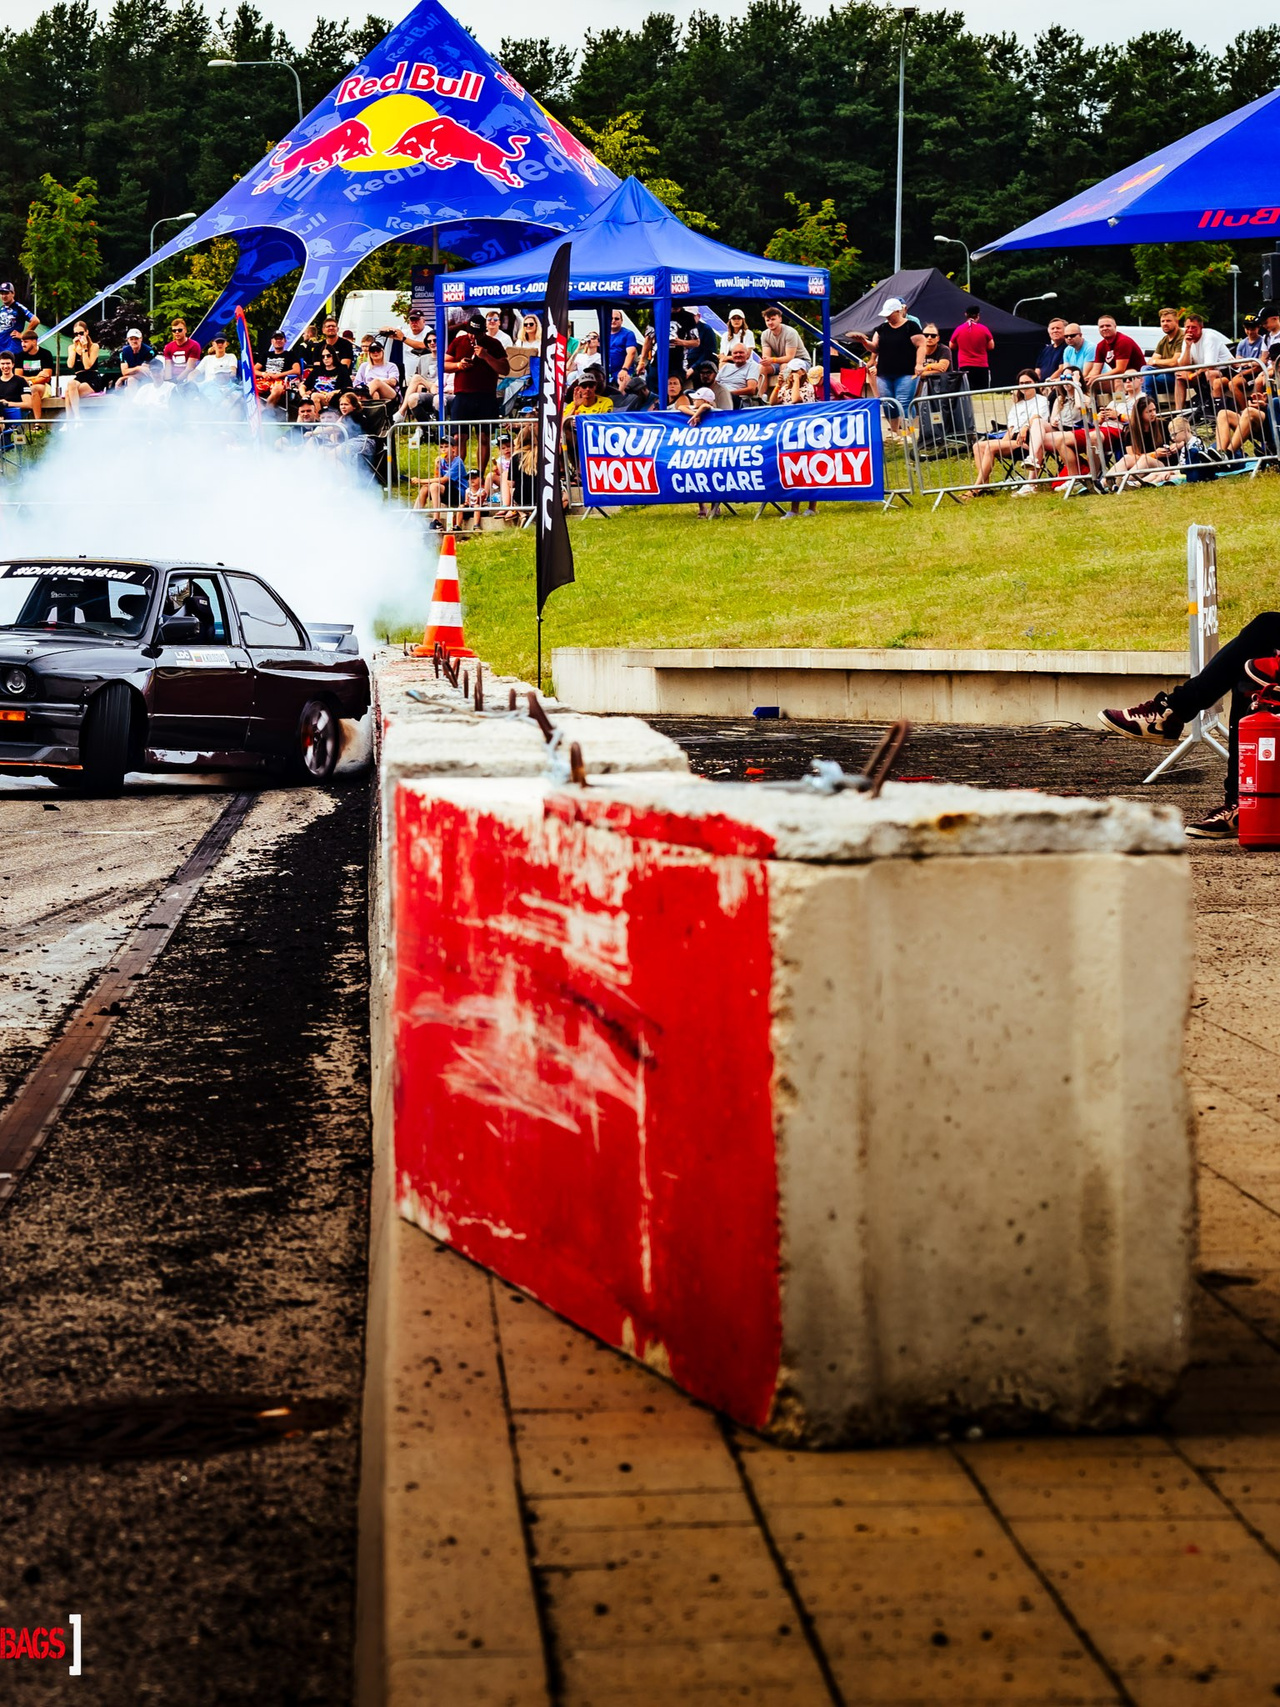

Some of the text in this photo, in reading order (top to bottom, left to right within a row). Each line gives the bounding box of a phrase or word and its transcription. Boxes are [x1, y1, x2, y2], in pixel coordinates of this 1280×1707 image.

[335, 61, 408, 105] Red
[407, 62, 485, 102] Bull
[630, 275, 655, 286] LIQUI
[671, 274, 689, 284] LIQUI
[714, 276, 786, 290] www.liqui-moly.com
[808, 275, 824, 286] LIQUI
[443, 283, 464, 293] LIQUI
[469, 286, 500, 297] MOTOR
[501, 284, 521, 295] OILS
[578, 282, 597, 292] CAR
[598, 280, 624, 291] CARE
[630, 285, 655, 295] MOLY
[672, 283, 690, 294] MOLY
[808, 285, 825, 295] MOLY
[443, 292, 465, 302] MOLY
[668, 422, 778, 446] MOTOR OILS
[782, 414, 865, 451] LIQUI
[586, 425, 665, 457] LIQUI
[667, 445, 764, 470] ADDITIVES
[589, 459, 653, 491] MOLY
[784, 451, 870, 486] MOLY
[672, 470, 766, 493] CAR CARE
